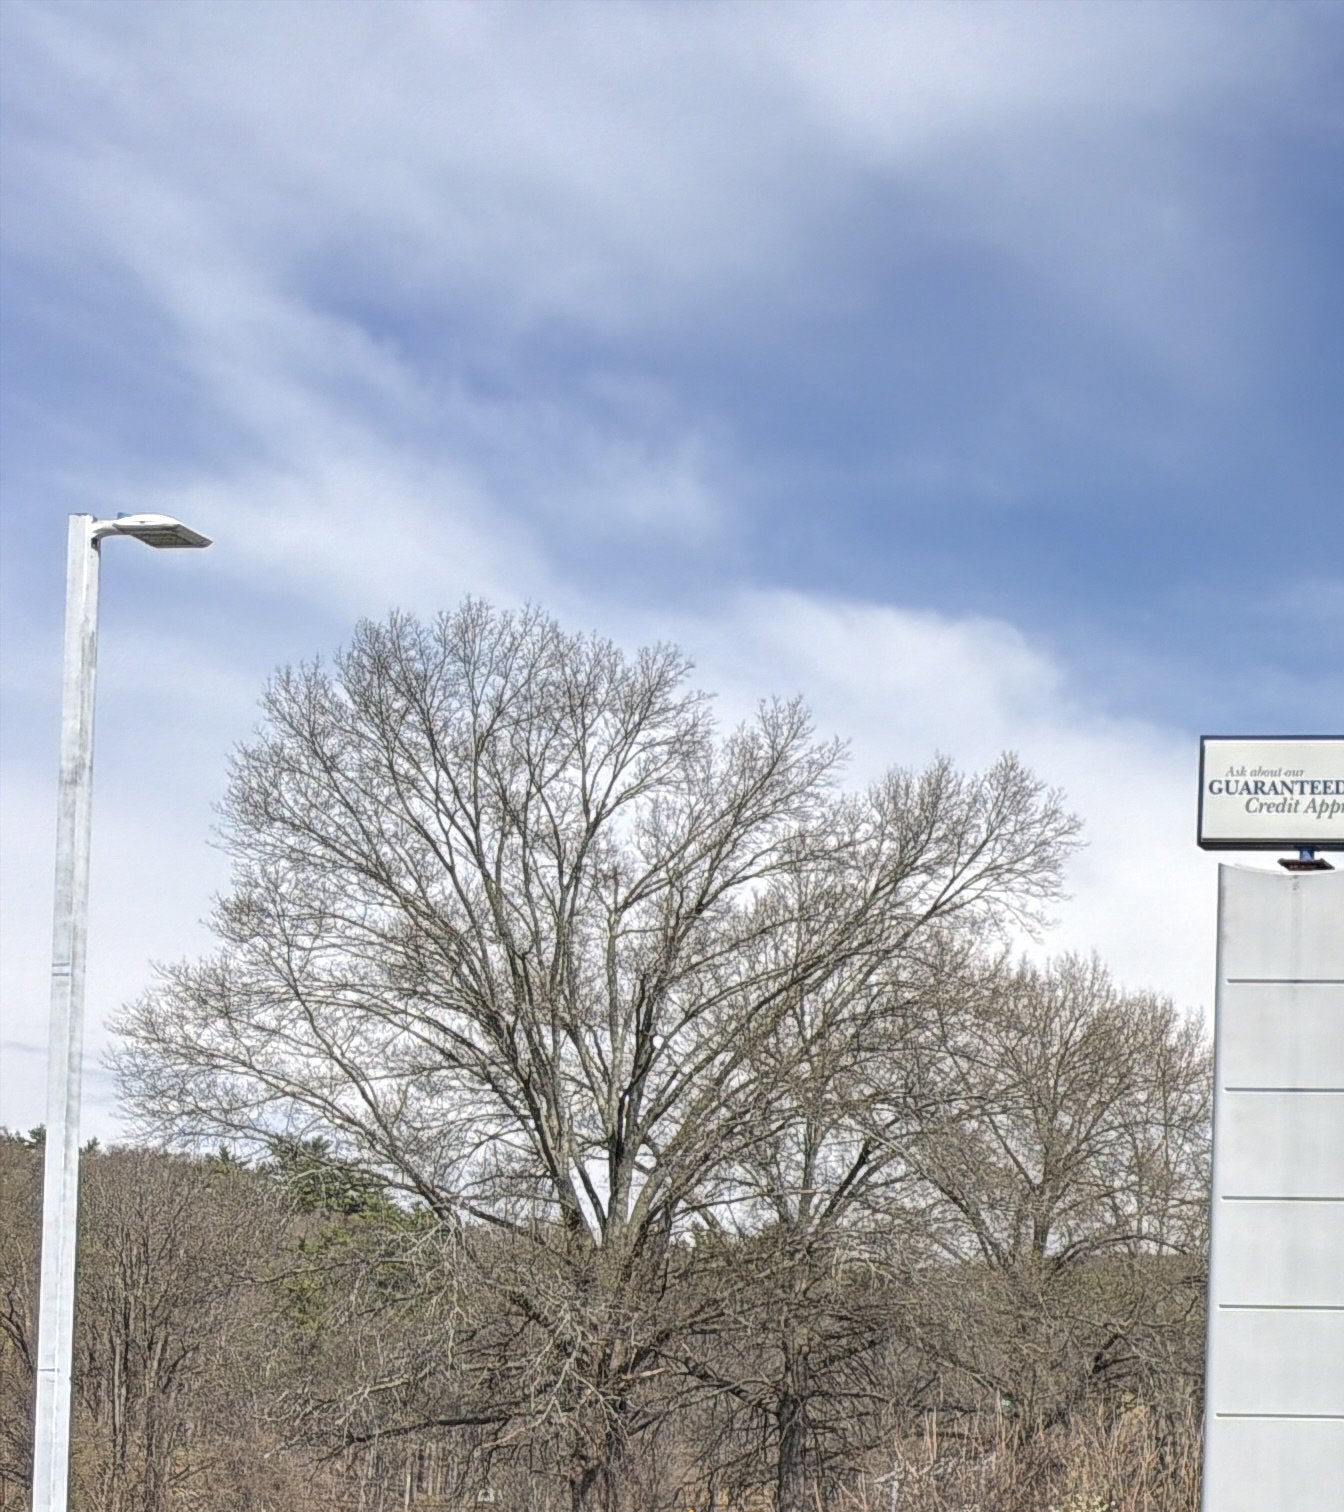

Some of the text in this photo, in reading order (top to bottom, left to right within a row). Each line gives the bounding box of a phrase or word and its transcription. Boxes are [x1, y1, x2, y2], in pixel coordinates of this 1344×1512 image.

[1225, 766, 1304, 777] Ask about our
[1245, 797, 1300, 814] Credit
